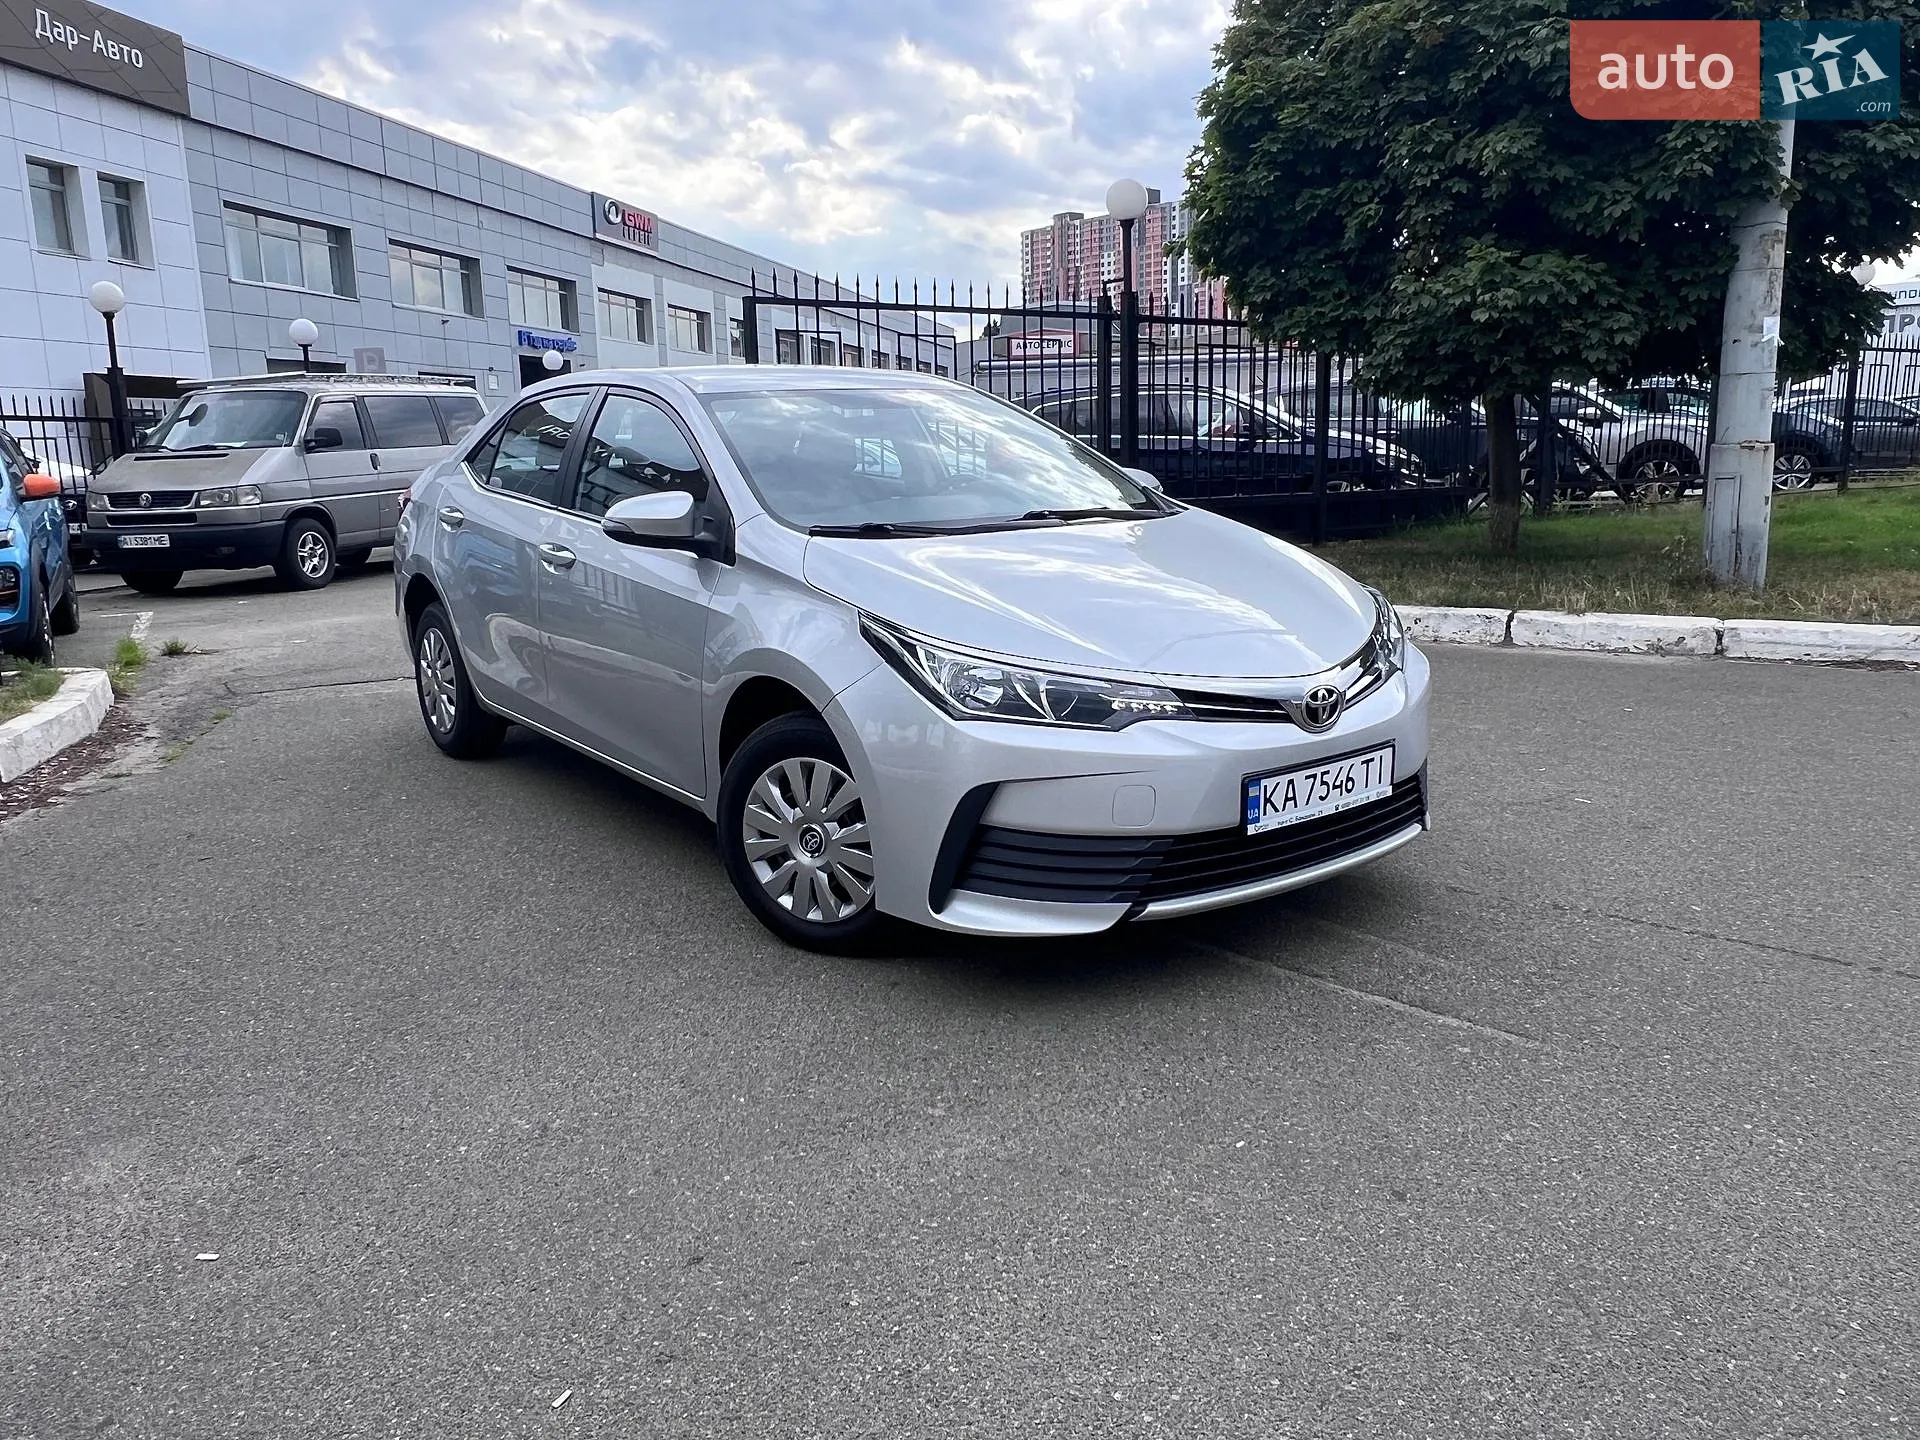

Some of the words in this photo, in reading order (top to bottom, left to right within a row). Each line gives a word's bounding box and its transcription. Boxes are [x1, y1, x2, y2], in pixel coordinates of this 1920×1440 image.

[35, 8, 143, 69] Дар-Авто
[1247, 808, 1259, 820] UA
[1262, 778, 1299, 817] KA
[1304, 763, 1355, 806] 7546
